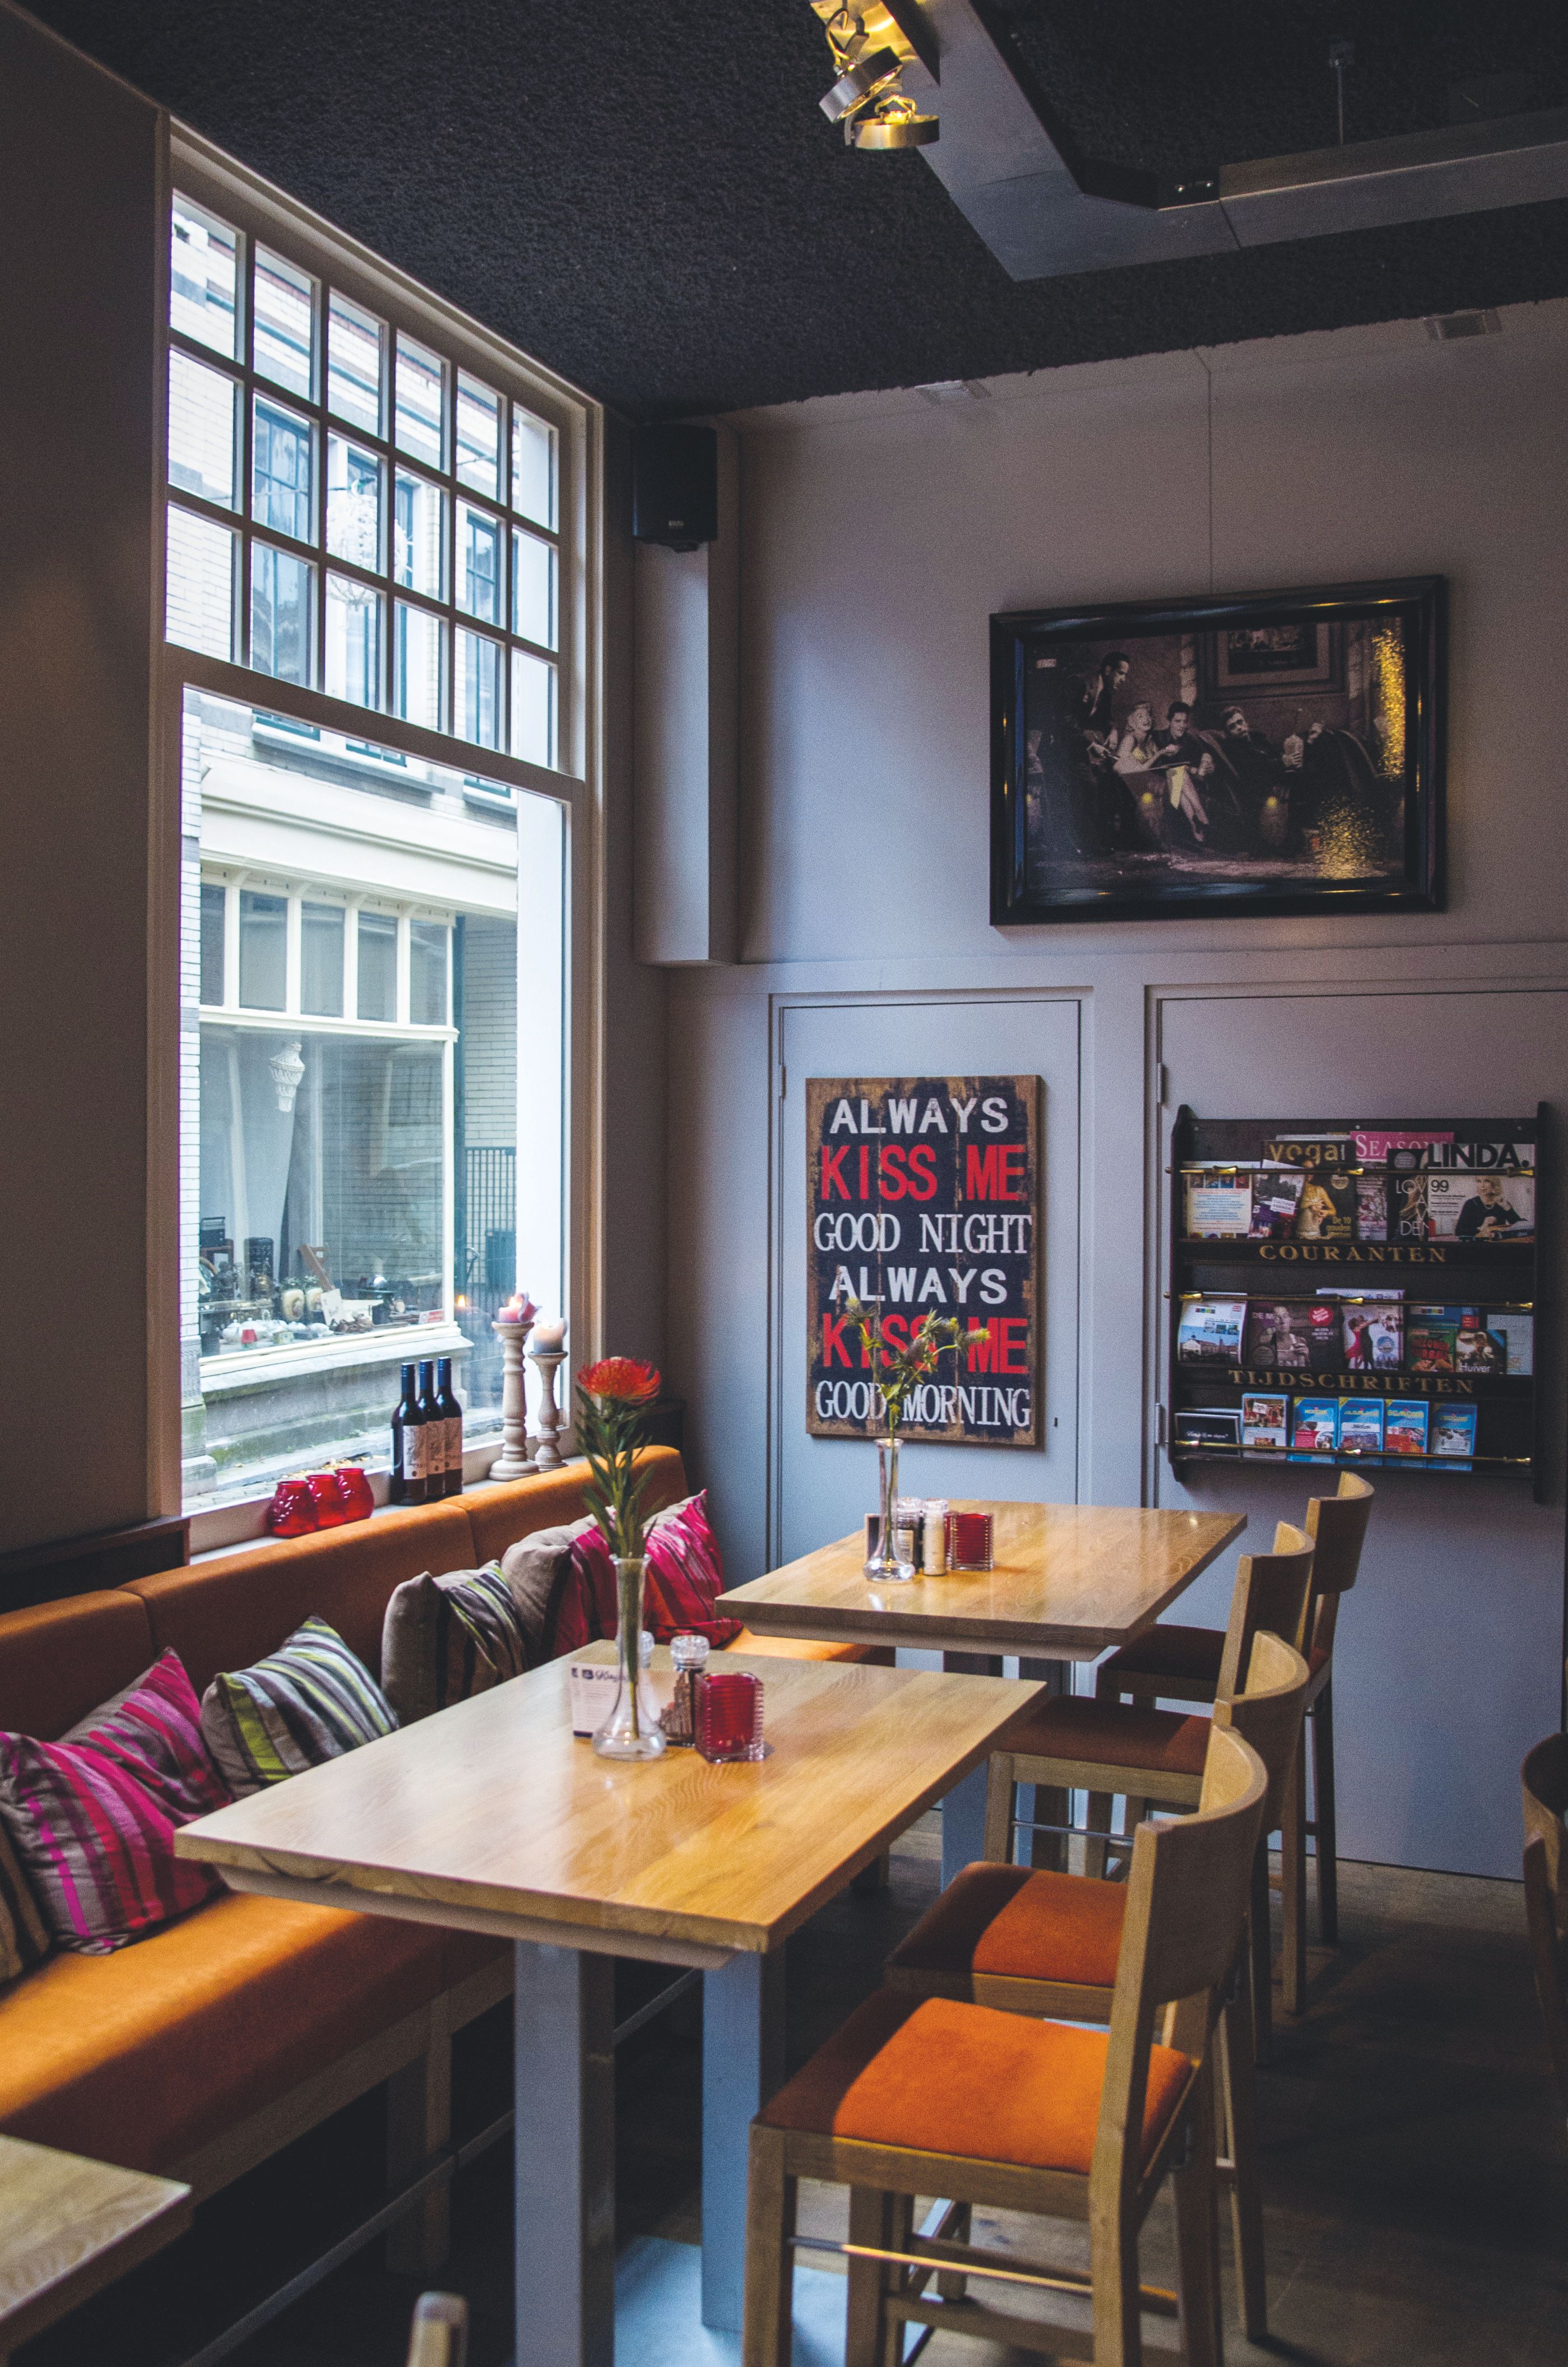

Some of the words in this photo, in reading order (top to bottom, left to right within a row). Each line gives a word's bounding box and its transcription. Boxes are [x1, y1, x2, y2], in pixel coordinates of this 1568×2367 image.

[830, 1097, 1009, 1134] ALWAYS
[821, 1144, 938, 1201] KISS
[966, 1144, 1028, 1200] ME
[1428, 1144, 1530, 1168] LINDA.
[1431, 1180, 1449, 1192] 99
[814, 1213, 901, 1252] GOOD
[919, 1214, 1032, 1254] NIGHT
[1259, 1245, 1446, 1262] COURANTEN
[829, 1265, 1008, 1305] ALWAYS
[967, 1316, 1028, 1374] ME
[1229, 1370, 1474, 1394] TIJDSCHRIFTEN
[815, 1380, 887, 1419] GOOD
[901, 1384, 1031, 1427] MORNING
